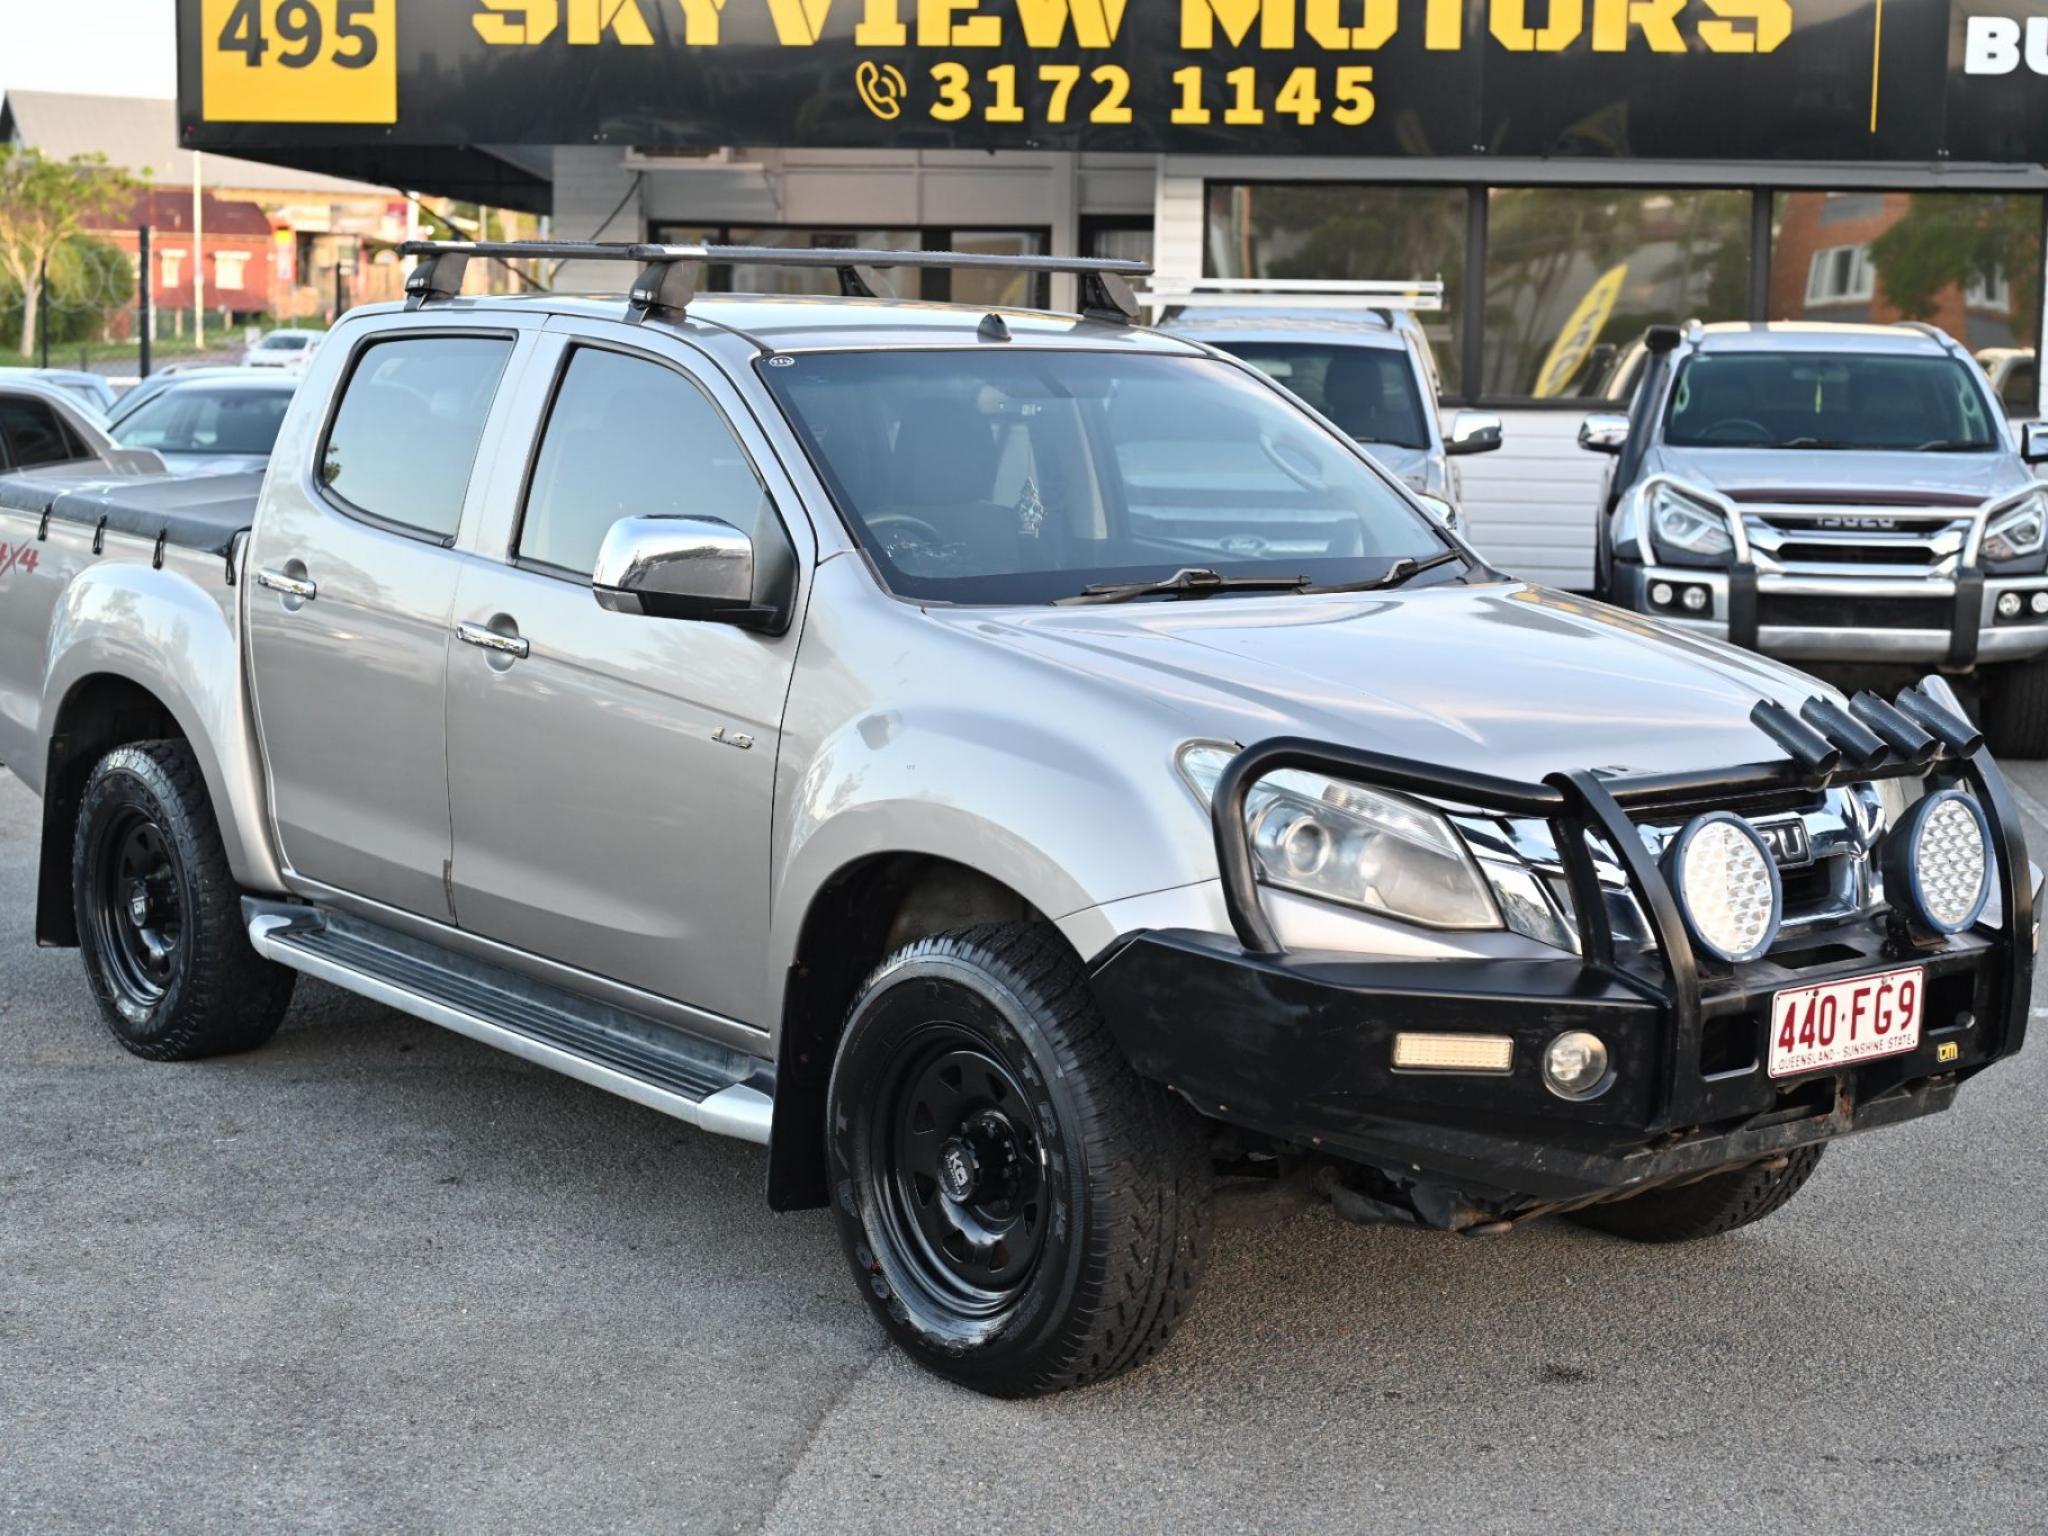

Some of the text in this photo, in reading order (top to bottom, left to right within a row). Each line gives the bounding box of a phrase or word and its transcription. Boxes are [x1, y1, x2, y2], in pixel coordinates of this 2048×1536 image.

[217, 0, 378, 69] 495
[472, 0, 1791, 53] SKYVIEW MOTORS
[928, 62, 1375, 125] 3172 1145
[1777, 980, 1915, 1053] 440 FG9
[1778, 1049, 1834, 1070] QUEENSLAND
[1843, 1039, 1884, 1057] SUNSHINE
[1888, 1033, 1912, 1049] STATE
